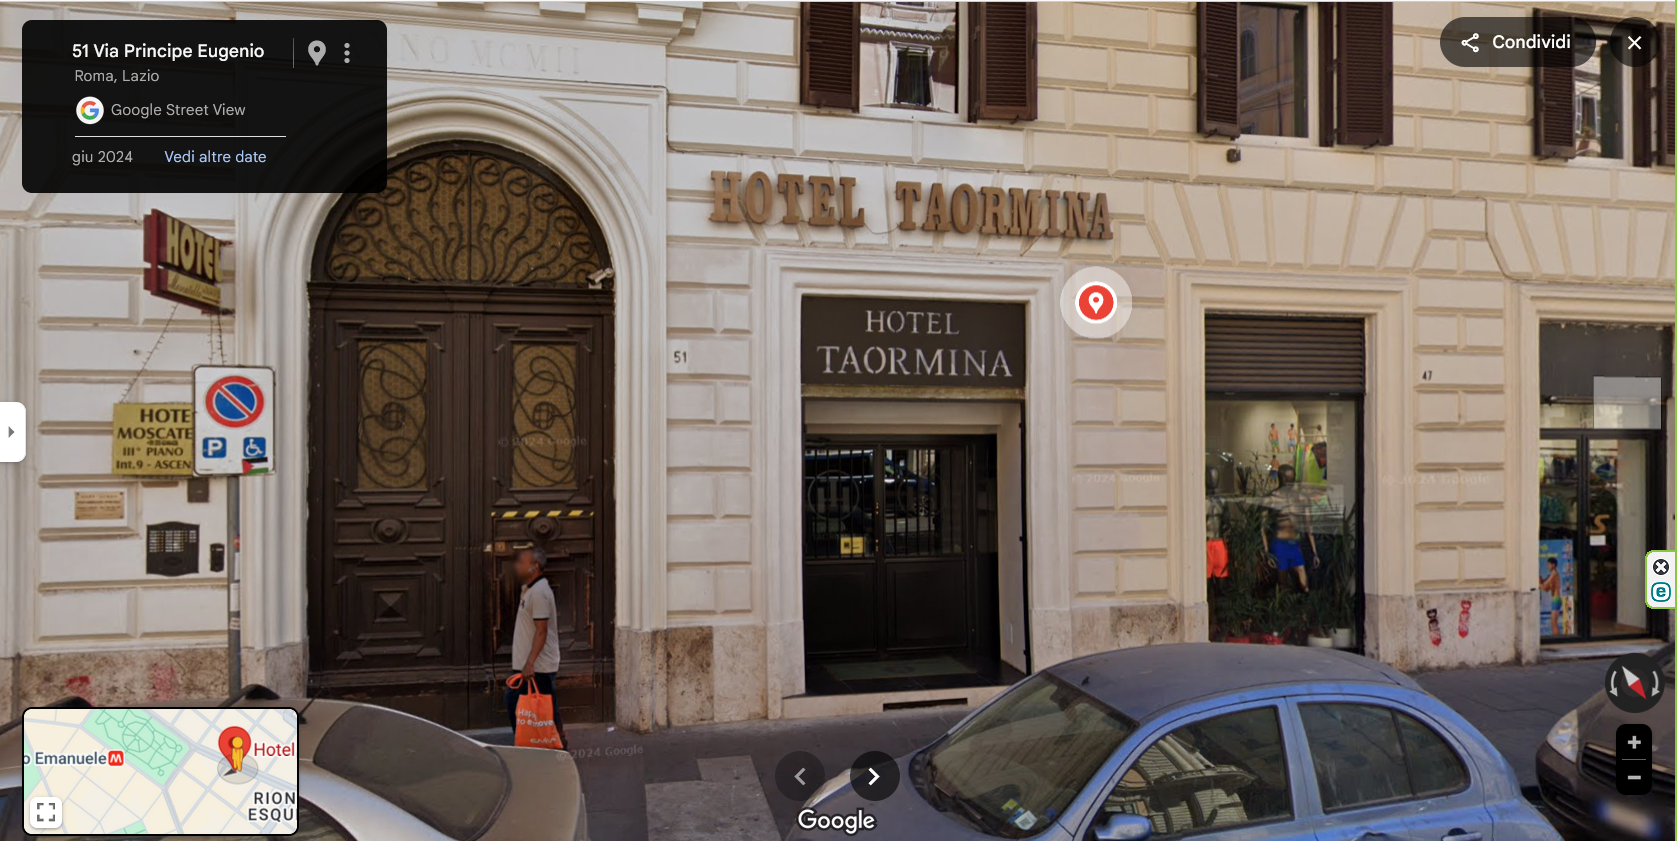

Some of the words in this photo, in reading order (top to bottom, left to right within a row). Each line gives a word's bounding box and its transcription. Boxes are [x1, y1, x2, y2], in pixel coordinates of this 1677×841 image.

[709, 170, 865, 229] HOTEL
[896, 181, 1114, 241] TAORMINA
[166, 216, 223, 283] HOTEL
[866, 309, 960, 336] HOTEL
[674, 350, 687, 363] 51
[816, 345, 1014, 378] TAORMINA
[1422, 370, 1432, 380] 47
[140, 408, 191, 423] HOTE
[117, 427, 193, 440] MOSCATE
[146, 447, 184, 457] PIANO
[207, 439, 223, 456] P
[155, 460, 191, 470] ASCEN
